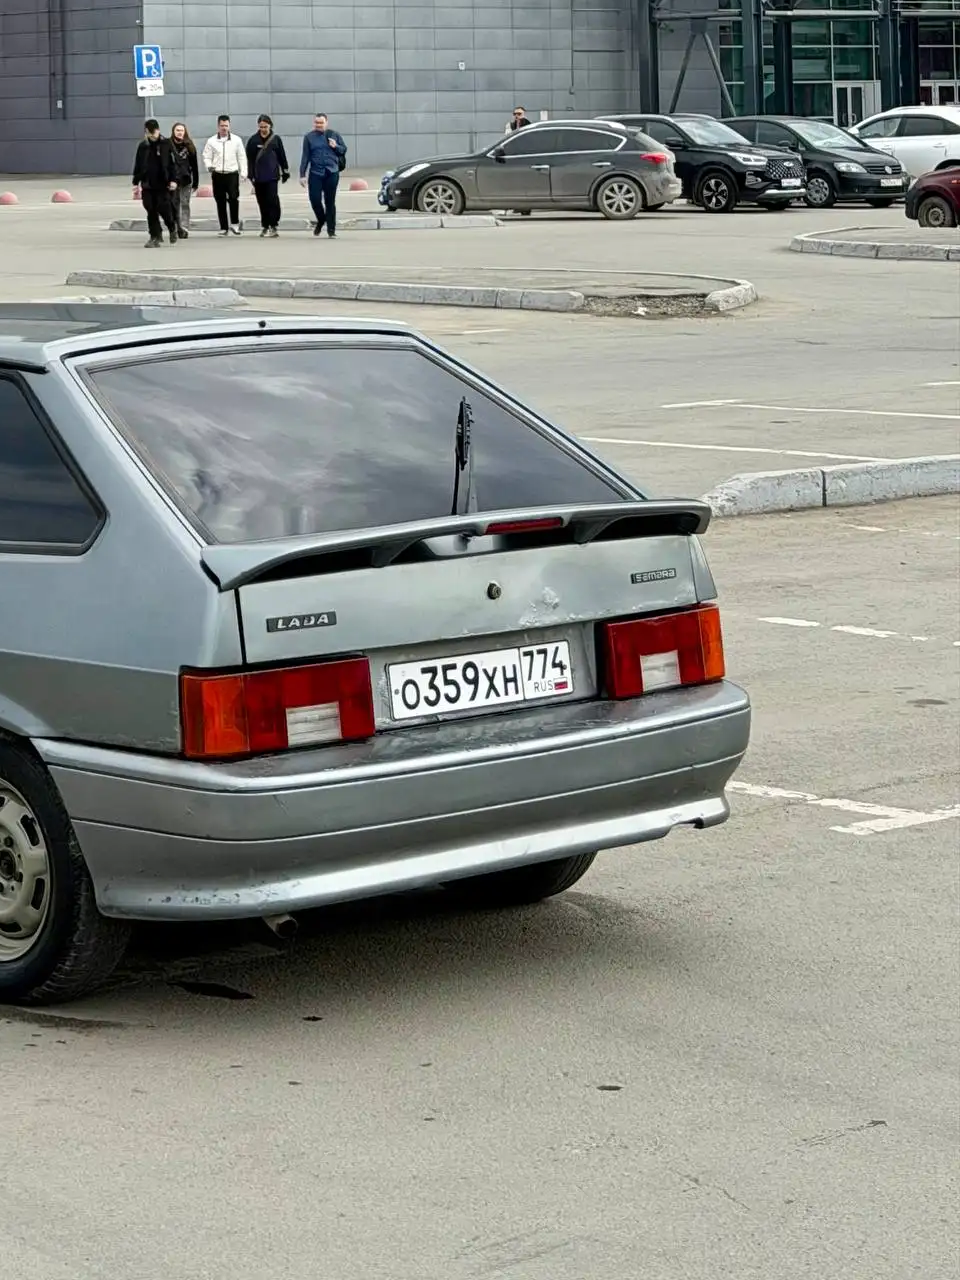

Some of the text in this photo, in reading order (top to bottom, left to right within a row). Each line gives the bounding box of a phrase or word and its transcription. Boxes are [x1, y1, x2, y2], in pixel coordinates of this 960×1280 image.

[142, 48, 157, 75] P
[277, 613, 329, 629] LADA
[401, 645, 565, 710] О359ХН 774
[534, 679, 554, 693] RUS
